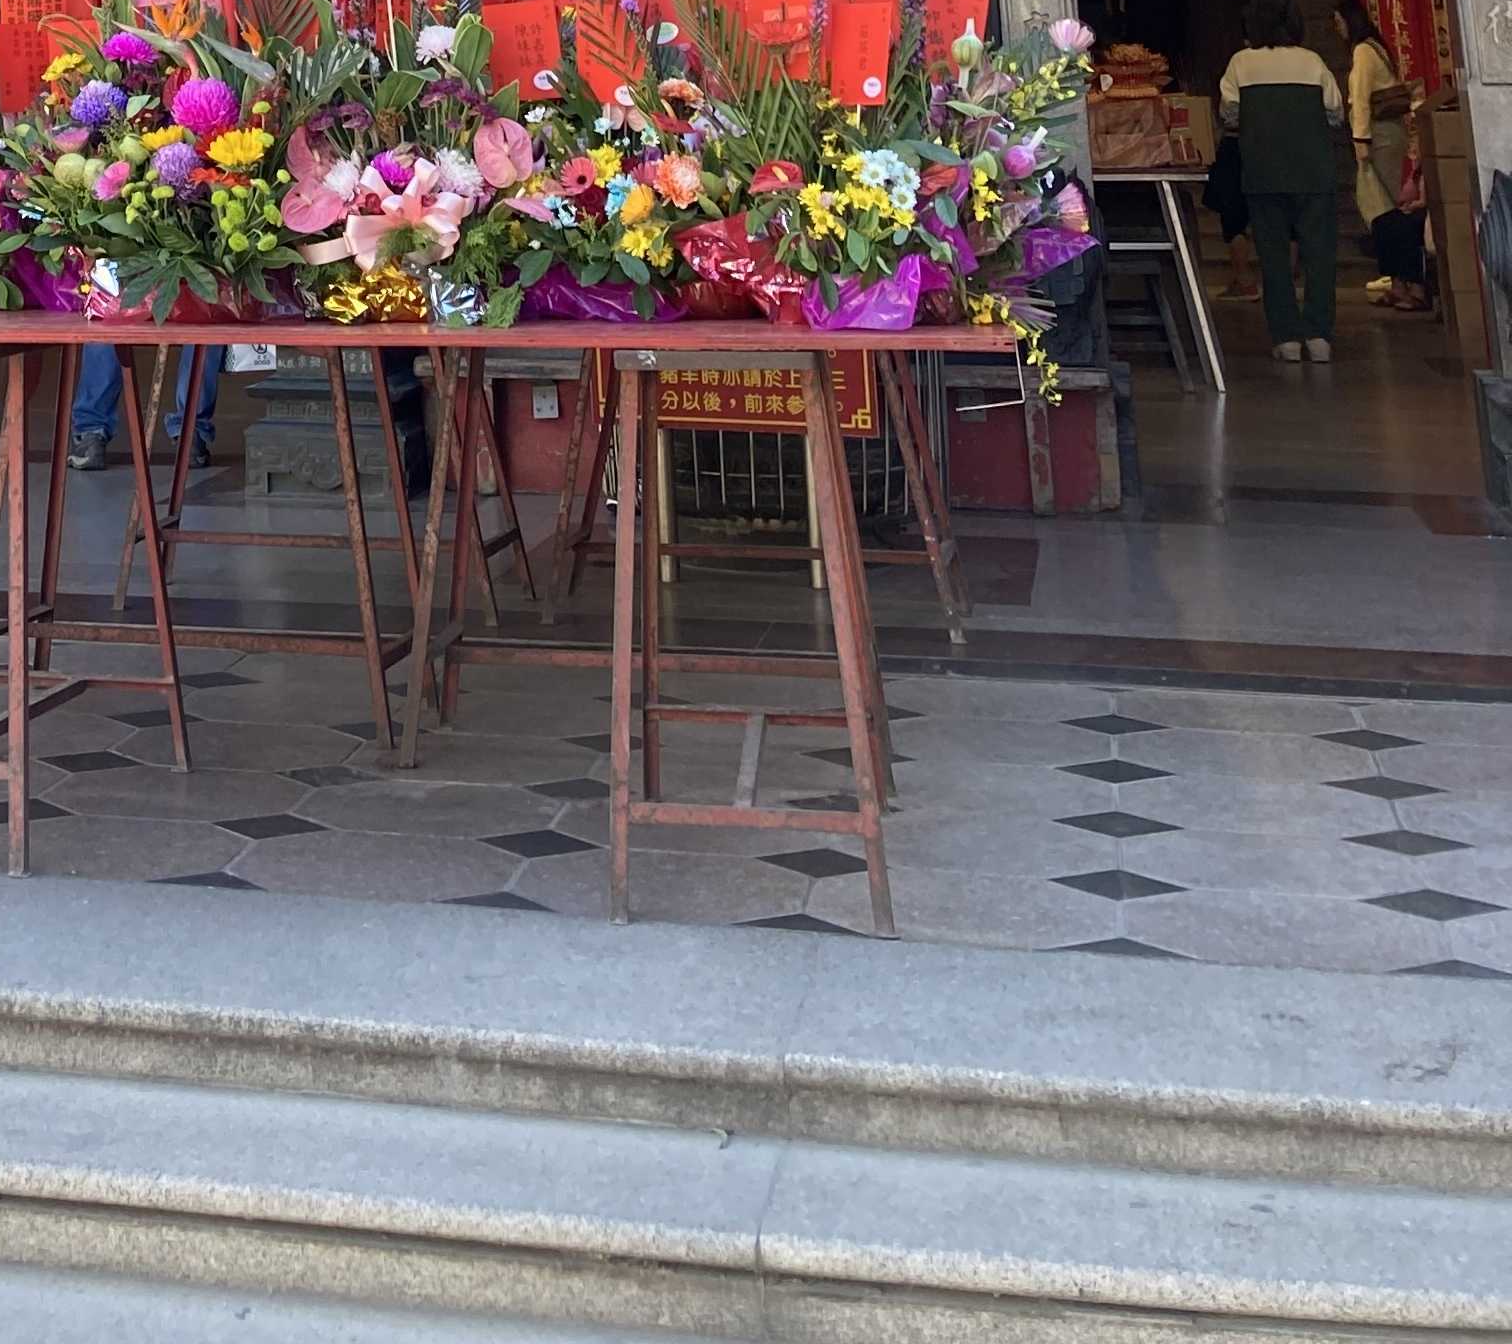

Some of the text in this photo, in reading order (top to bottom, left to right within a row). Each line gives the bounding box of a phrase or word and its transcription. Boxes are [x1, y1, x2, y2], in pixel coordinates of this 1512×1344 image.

[661, 390, 844, 415] 分以後，前來參。
